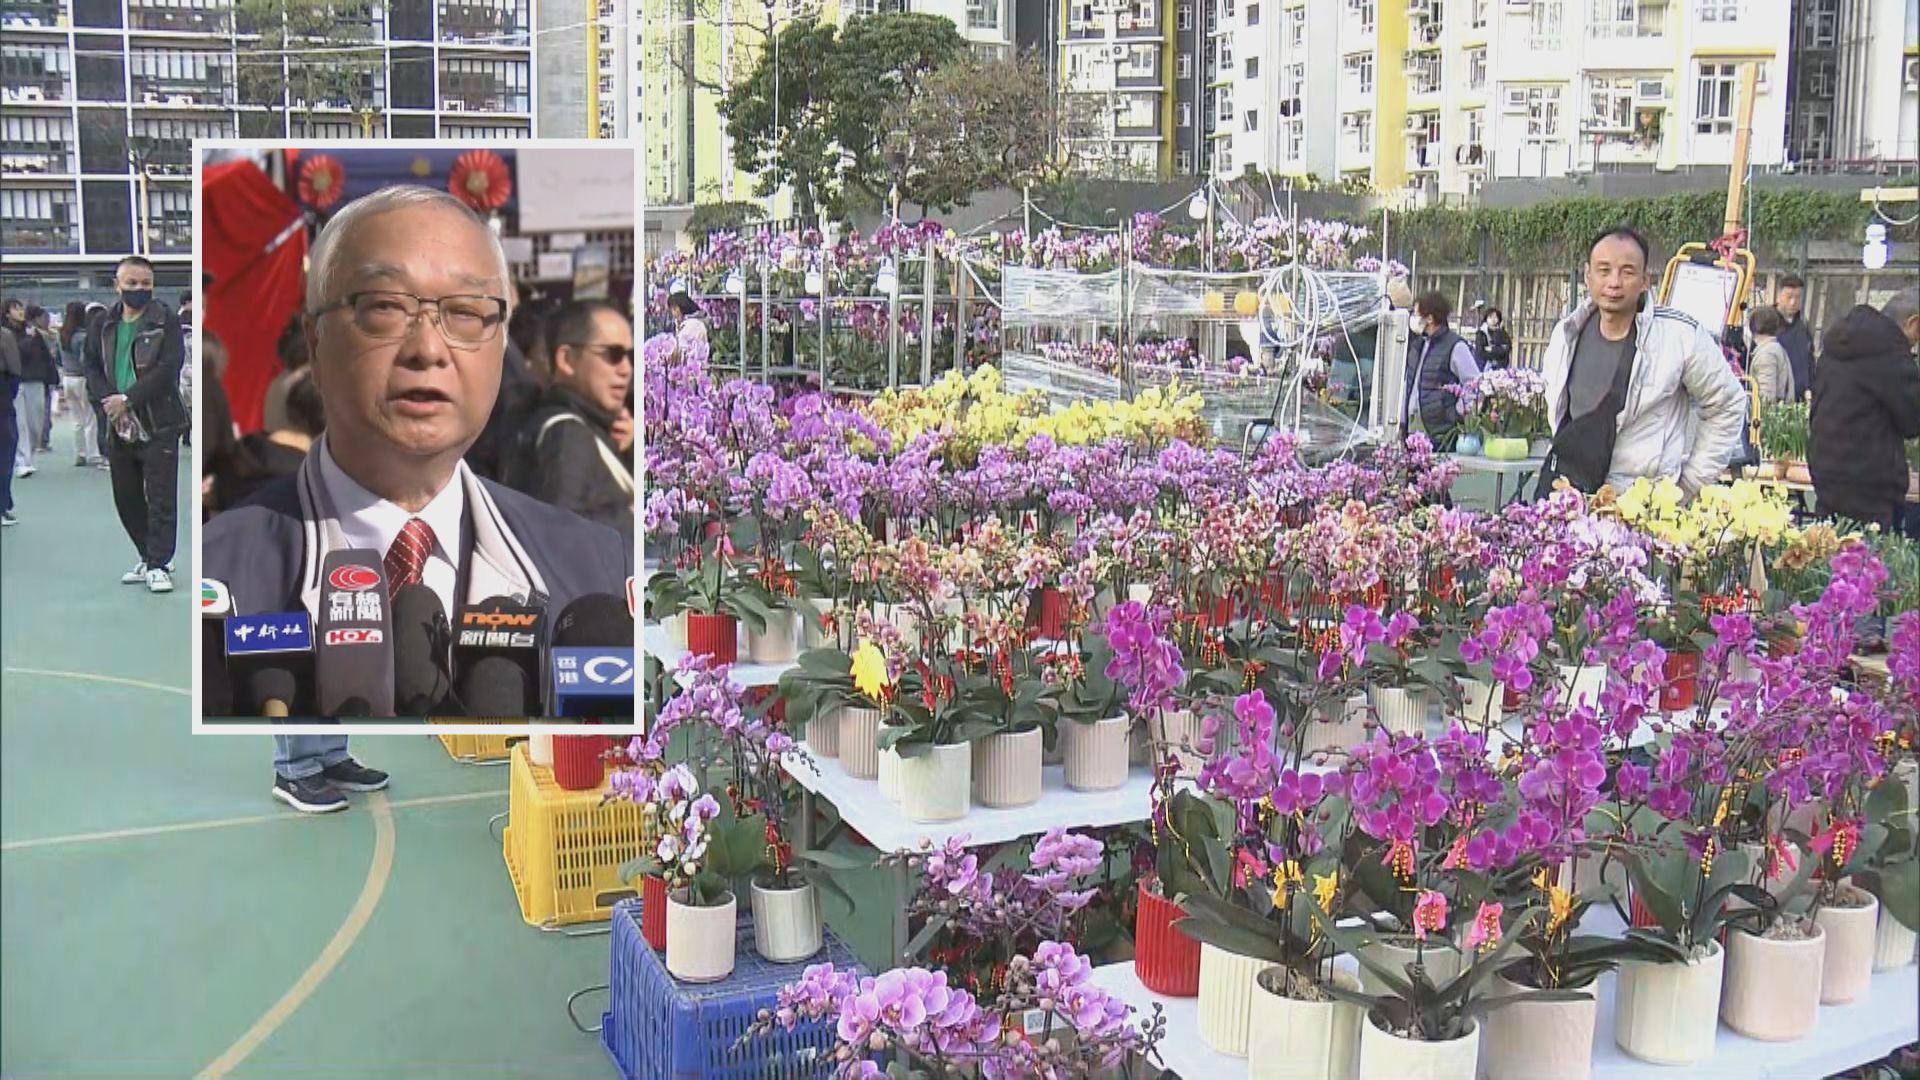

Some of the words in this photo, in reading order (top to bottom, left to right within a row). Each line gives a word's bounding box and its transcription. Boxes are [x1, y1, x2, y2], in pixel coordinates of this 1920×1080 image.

[328, 591, 381, 607] 有線
[329, 606, 382, 622] 新聞
[463, 612, 538, 627] now
[234, 623, 303, 643] 中新社
[330, 630, 370, 643] HOY
[459, 630, 535, 647] 新聞台
[558, 656, 579, 684] 香港
